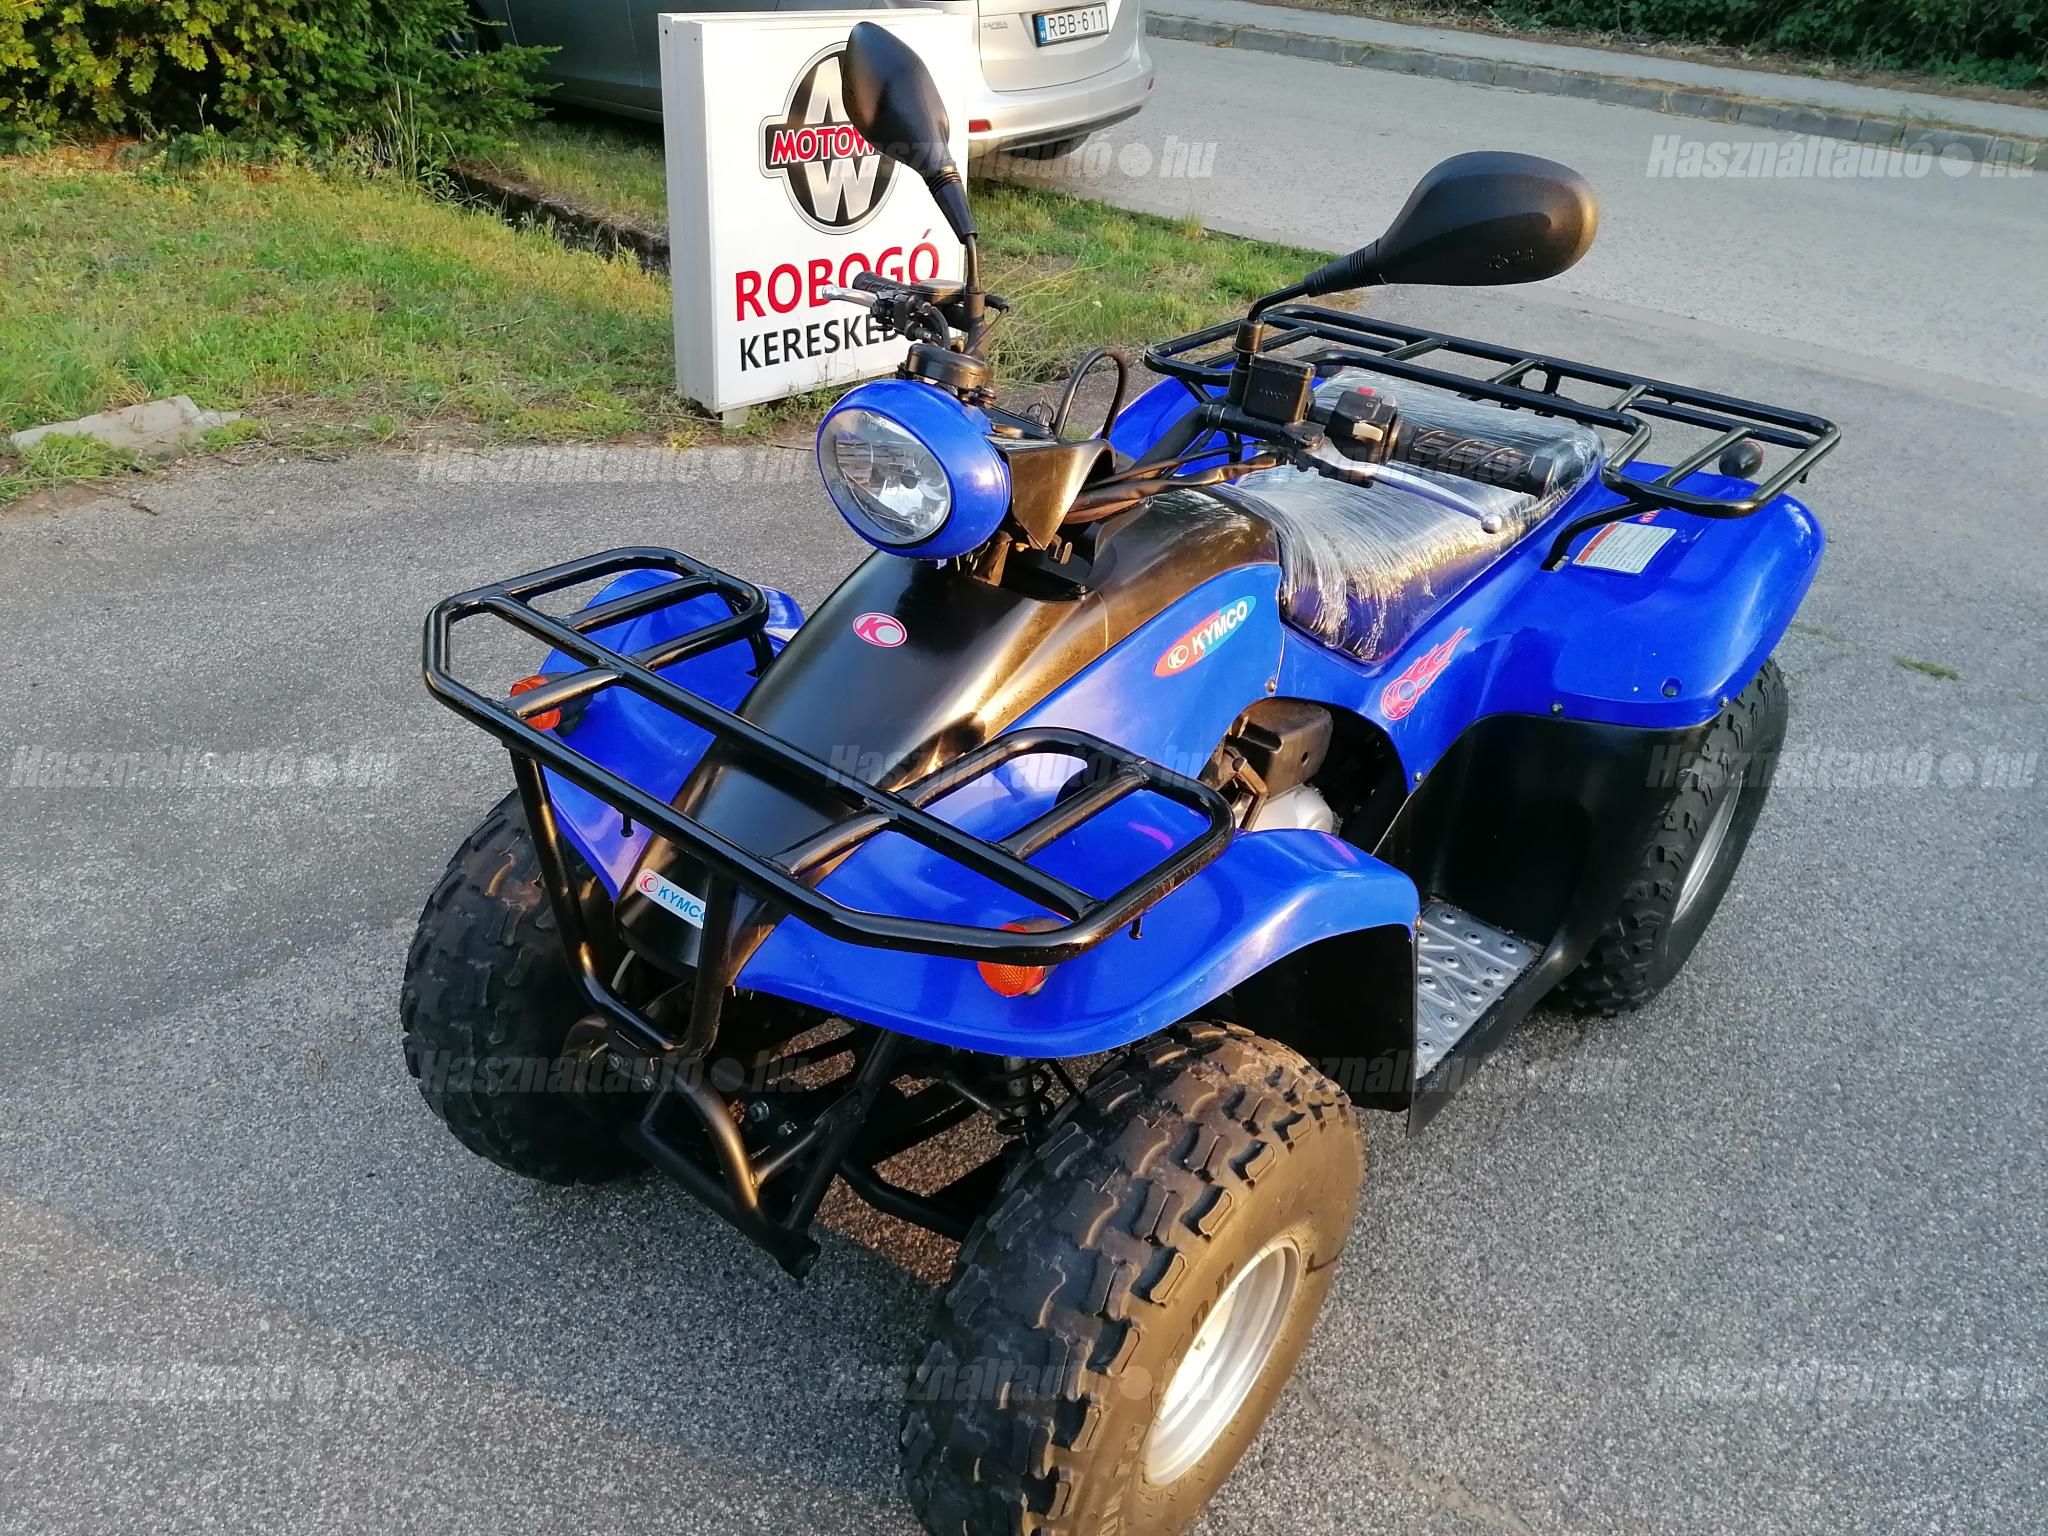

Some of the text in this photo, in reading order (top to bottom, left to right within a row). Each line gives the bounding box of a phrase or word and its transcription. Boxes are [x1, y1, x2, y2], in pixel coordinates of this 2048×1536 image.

[1048, 8, 1105, 38] RBB-611
[769, 121, 876, 165] MOTOW
[735, 228, 940, 322] ROBOGÓ
[740, 313, 900, 373] KERESKED
[1191, 600, 1248, 656] KYMCO
